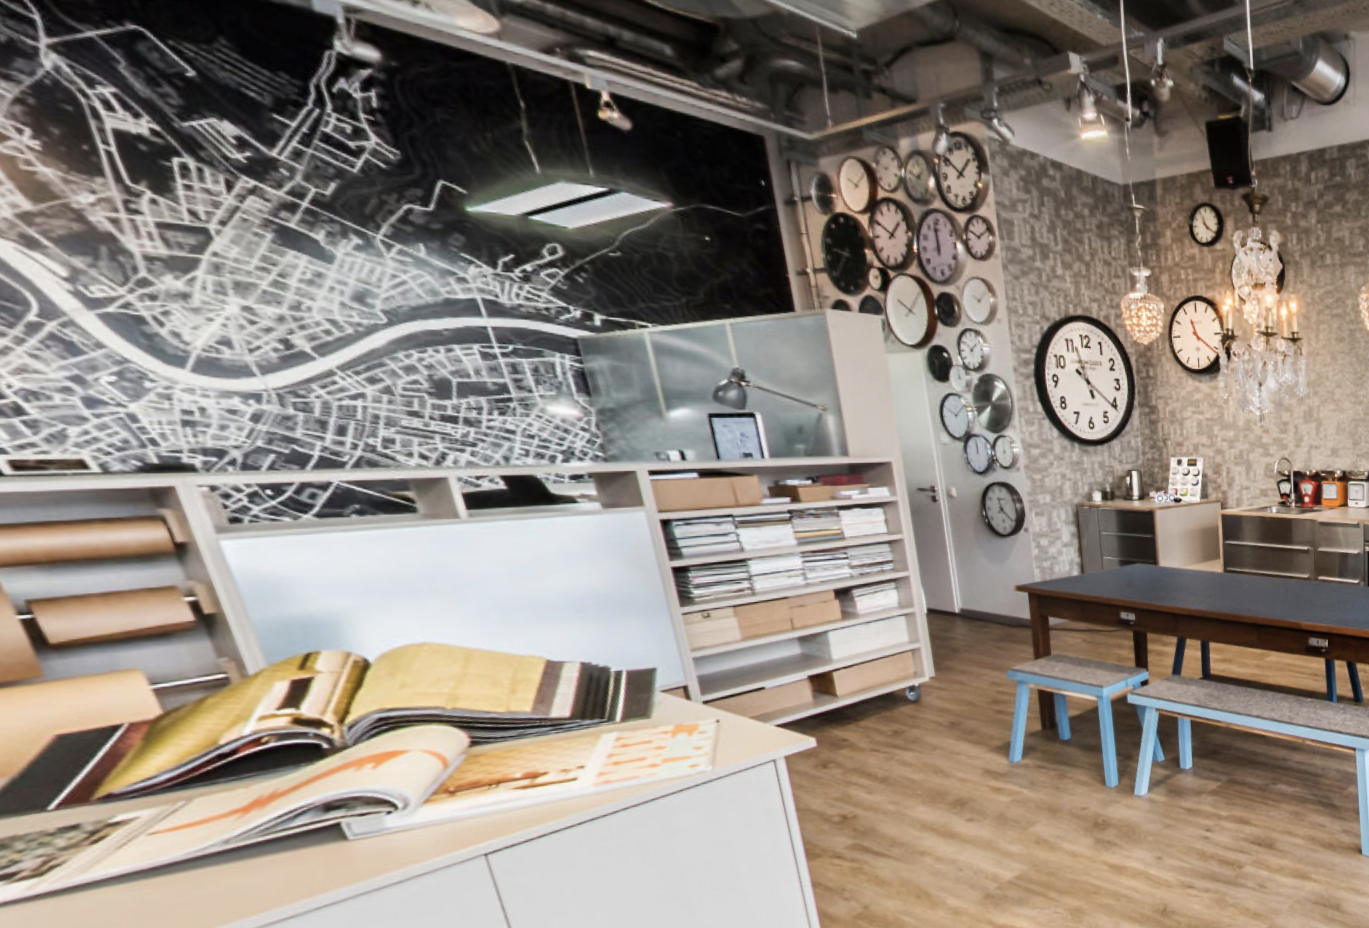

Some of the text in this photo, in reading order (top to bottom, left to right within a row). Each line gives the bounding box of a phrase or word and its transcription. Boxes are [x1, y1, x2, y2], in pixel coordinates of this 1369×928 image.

[1065, 338, 1075, 353] 11
[1079, 334, 1092, 349] 12
[1098, 341, 1103, 355] 1
[1053, 354, 1066, 369] 10
[1108, 358, 1115, 371] 2
[1052, 373, 1059, 388] 9
[1114, 379, 1121, 391] 3
[1060, 396, 1067, 410] 8
[1073, 411, 1080, 424] 7
[1088, 416, 1095, 429] 6
[1103, 411, 1109, 423] 5
